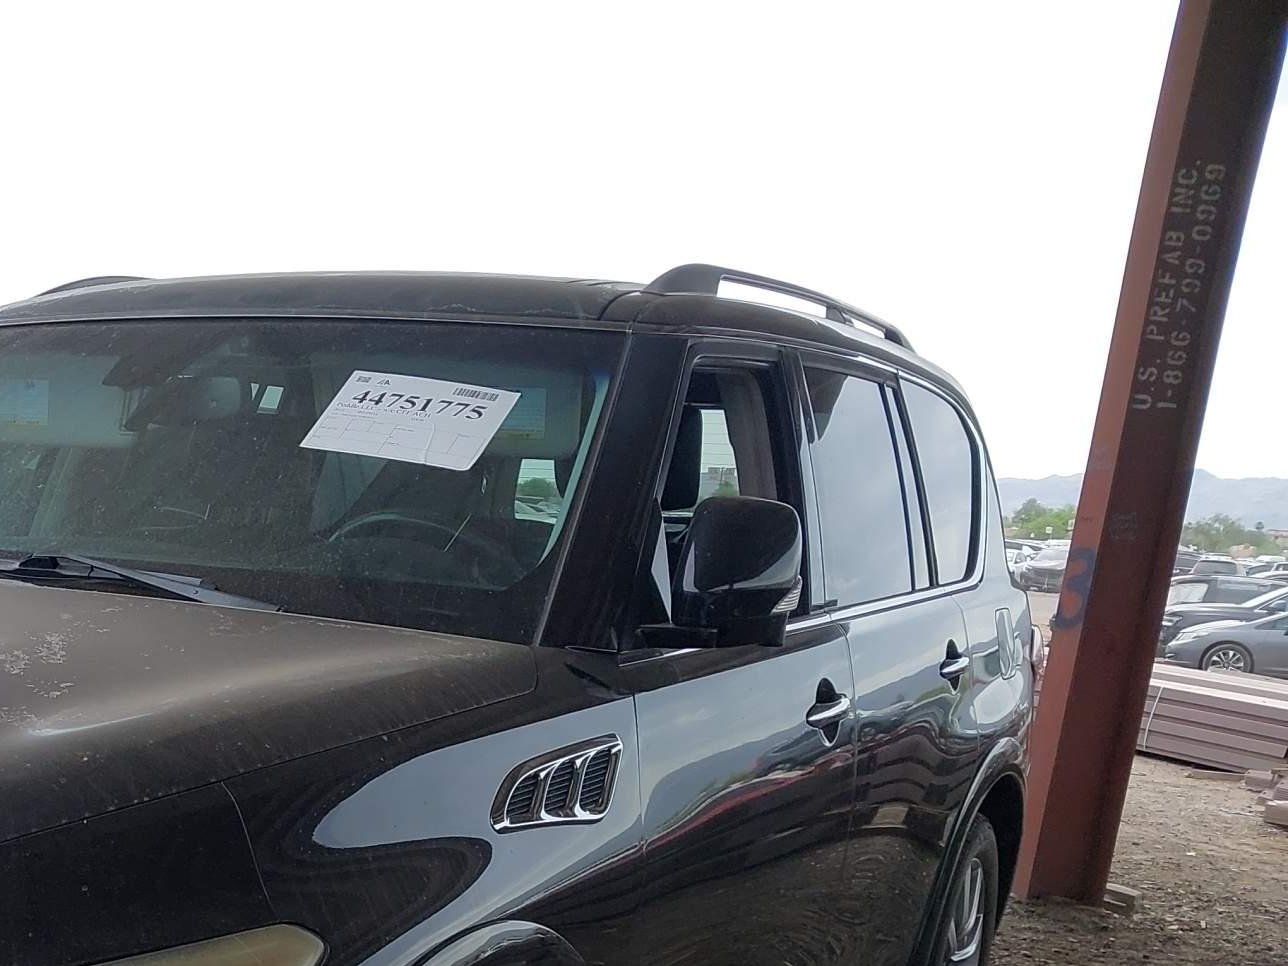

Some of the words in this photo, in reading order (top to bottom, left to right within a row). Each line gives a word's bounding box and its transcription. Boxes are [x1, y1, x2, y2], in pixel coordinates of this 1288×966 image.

[1170, 159, 1201, 214] INC.
[1146, 231, 1186, 341] PREFAB
[352, 390, 488, 420] 44751775
[1132, 358, 1161, 411] U.S.
